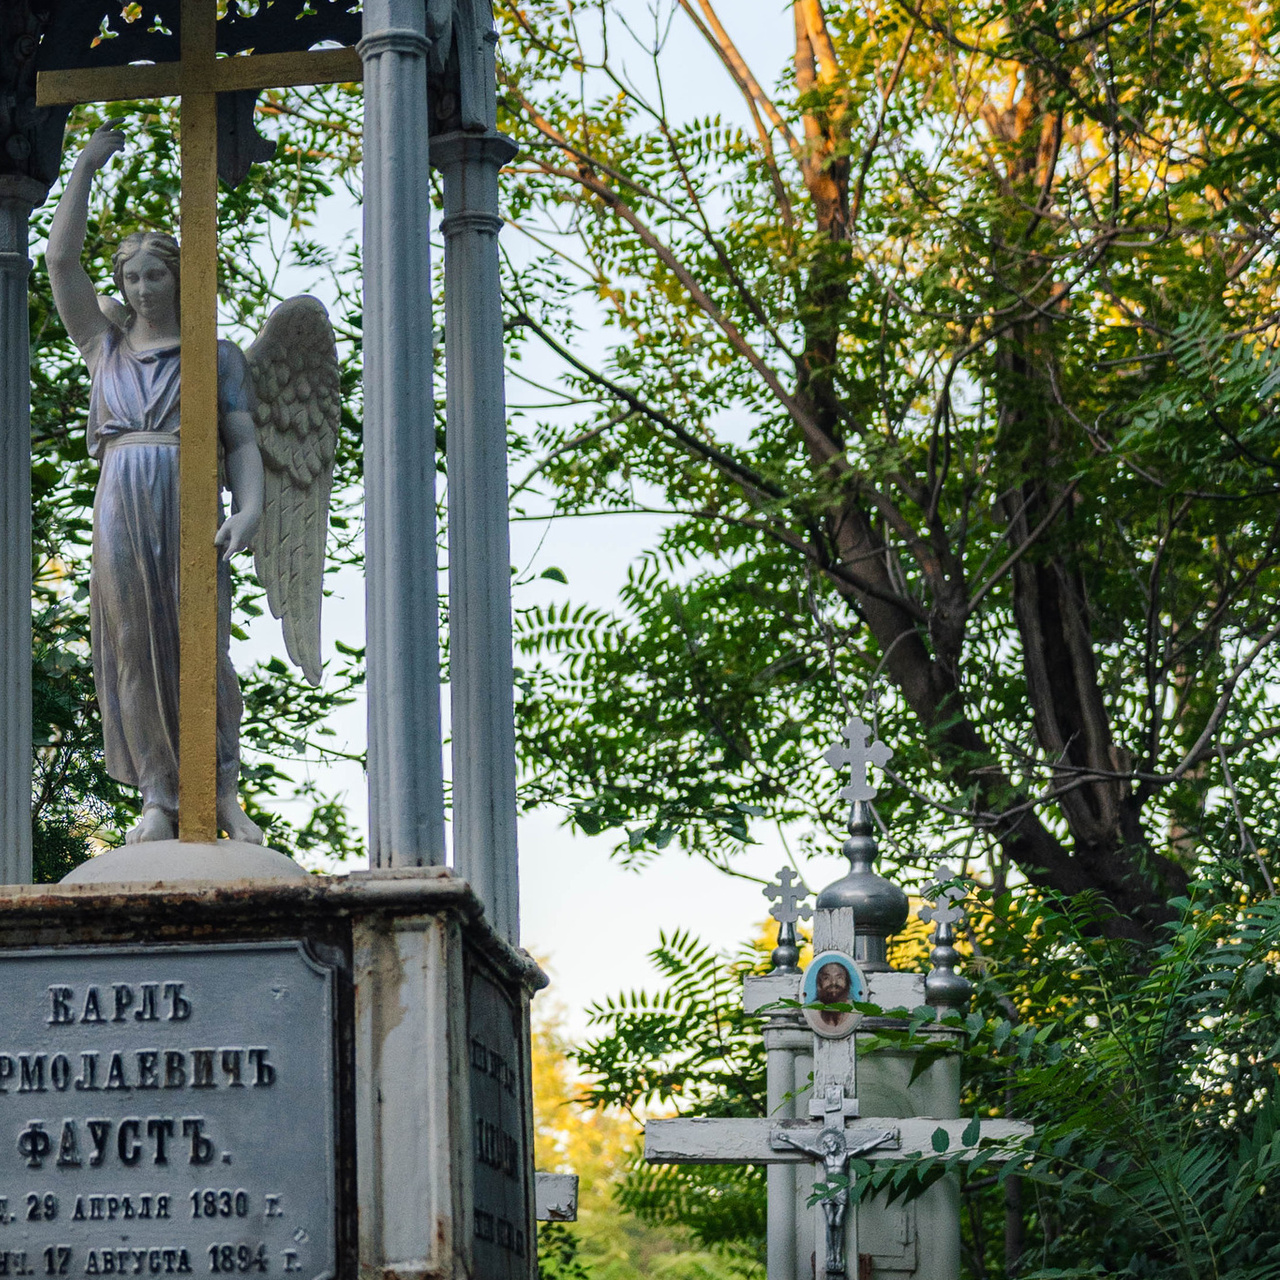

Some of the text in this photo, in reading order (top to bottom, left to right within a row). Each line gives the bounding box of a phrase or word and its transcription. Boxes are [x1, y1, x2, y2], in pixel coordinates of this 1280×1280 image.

[47, 981, 192, 1024] КАРЛЪ
[17, 1116, 232, 1167] ФАУСТЪ.
[25, 1190, 60, 1222] 29
[189, 1187, 250, 1218] 1830
[43, 1243, 72, 1276] 17
[85, 1246, 192, 1275] АВГУСТА
[206, 1241, 268, 1273] 1894
